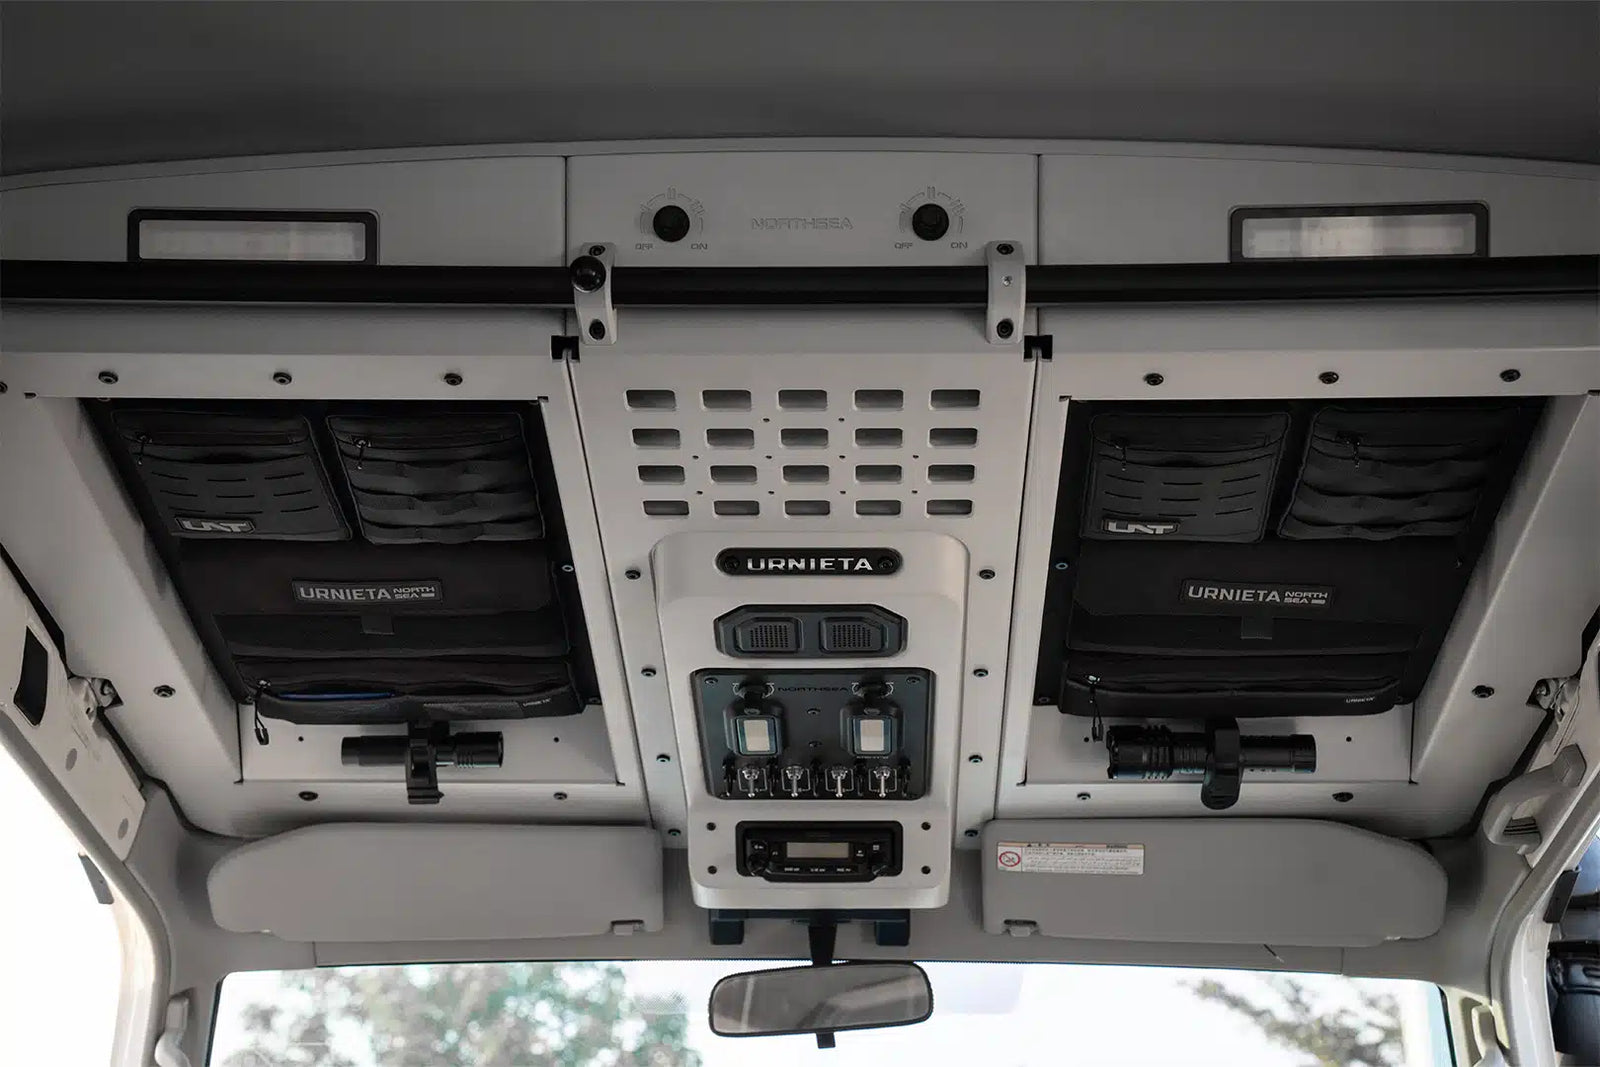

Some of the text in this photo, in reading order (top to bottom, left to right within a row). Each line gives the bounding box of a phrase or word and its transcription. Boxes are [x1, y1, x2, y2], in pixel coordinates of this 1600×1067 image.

[751, 216, 854, 230] NORTHSEA
[690, 242, 708, 250] ON
[950, 240, 968, 249] ON
[747, 557, 873, 571] URNIETA
[300, 586, 391, 600] URNIETA
[1188, 585, 1281, 602] URNIETA
